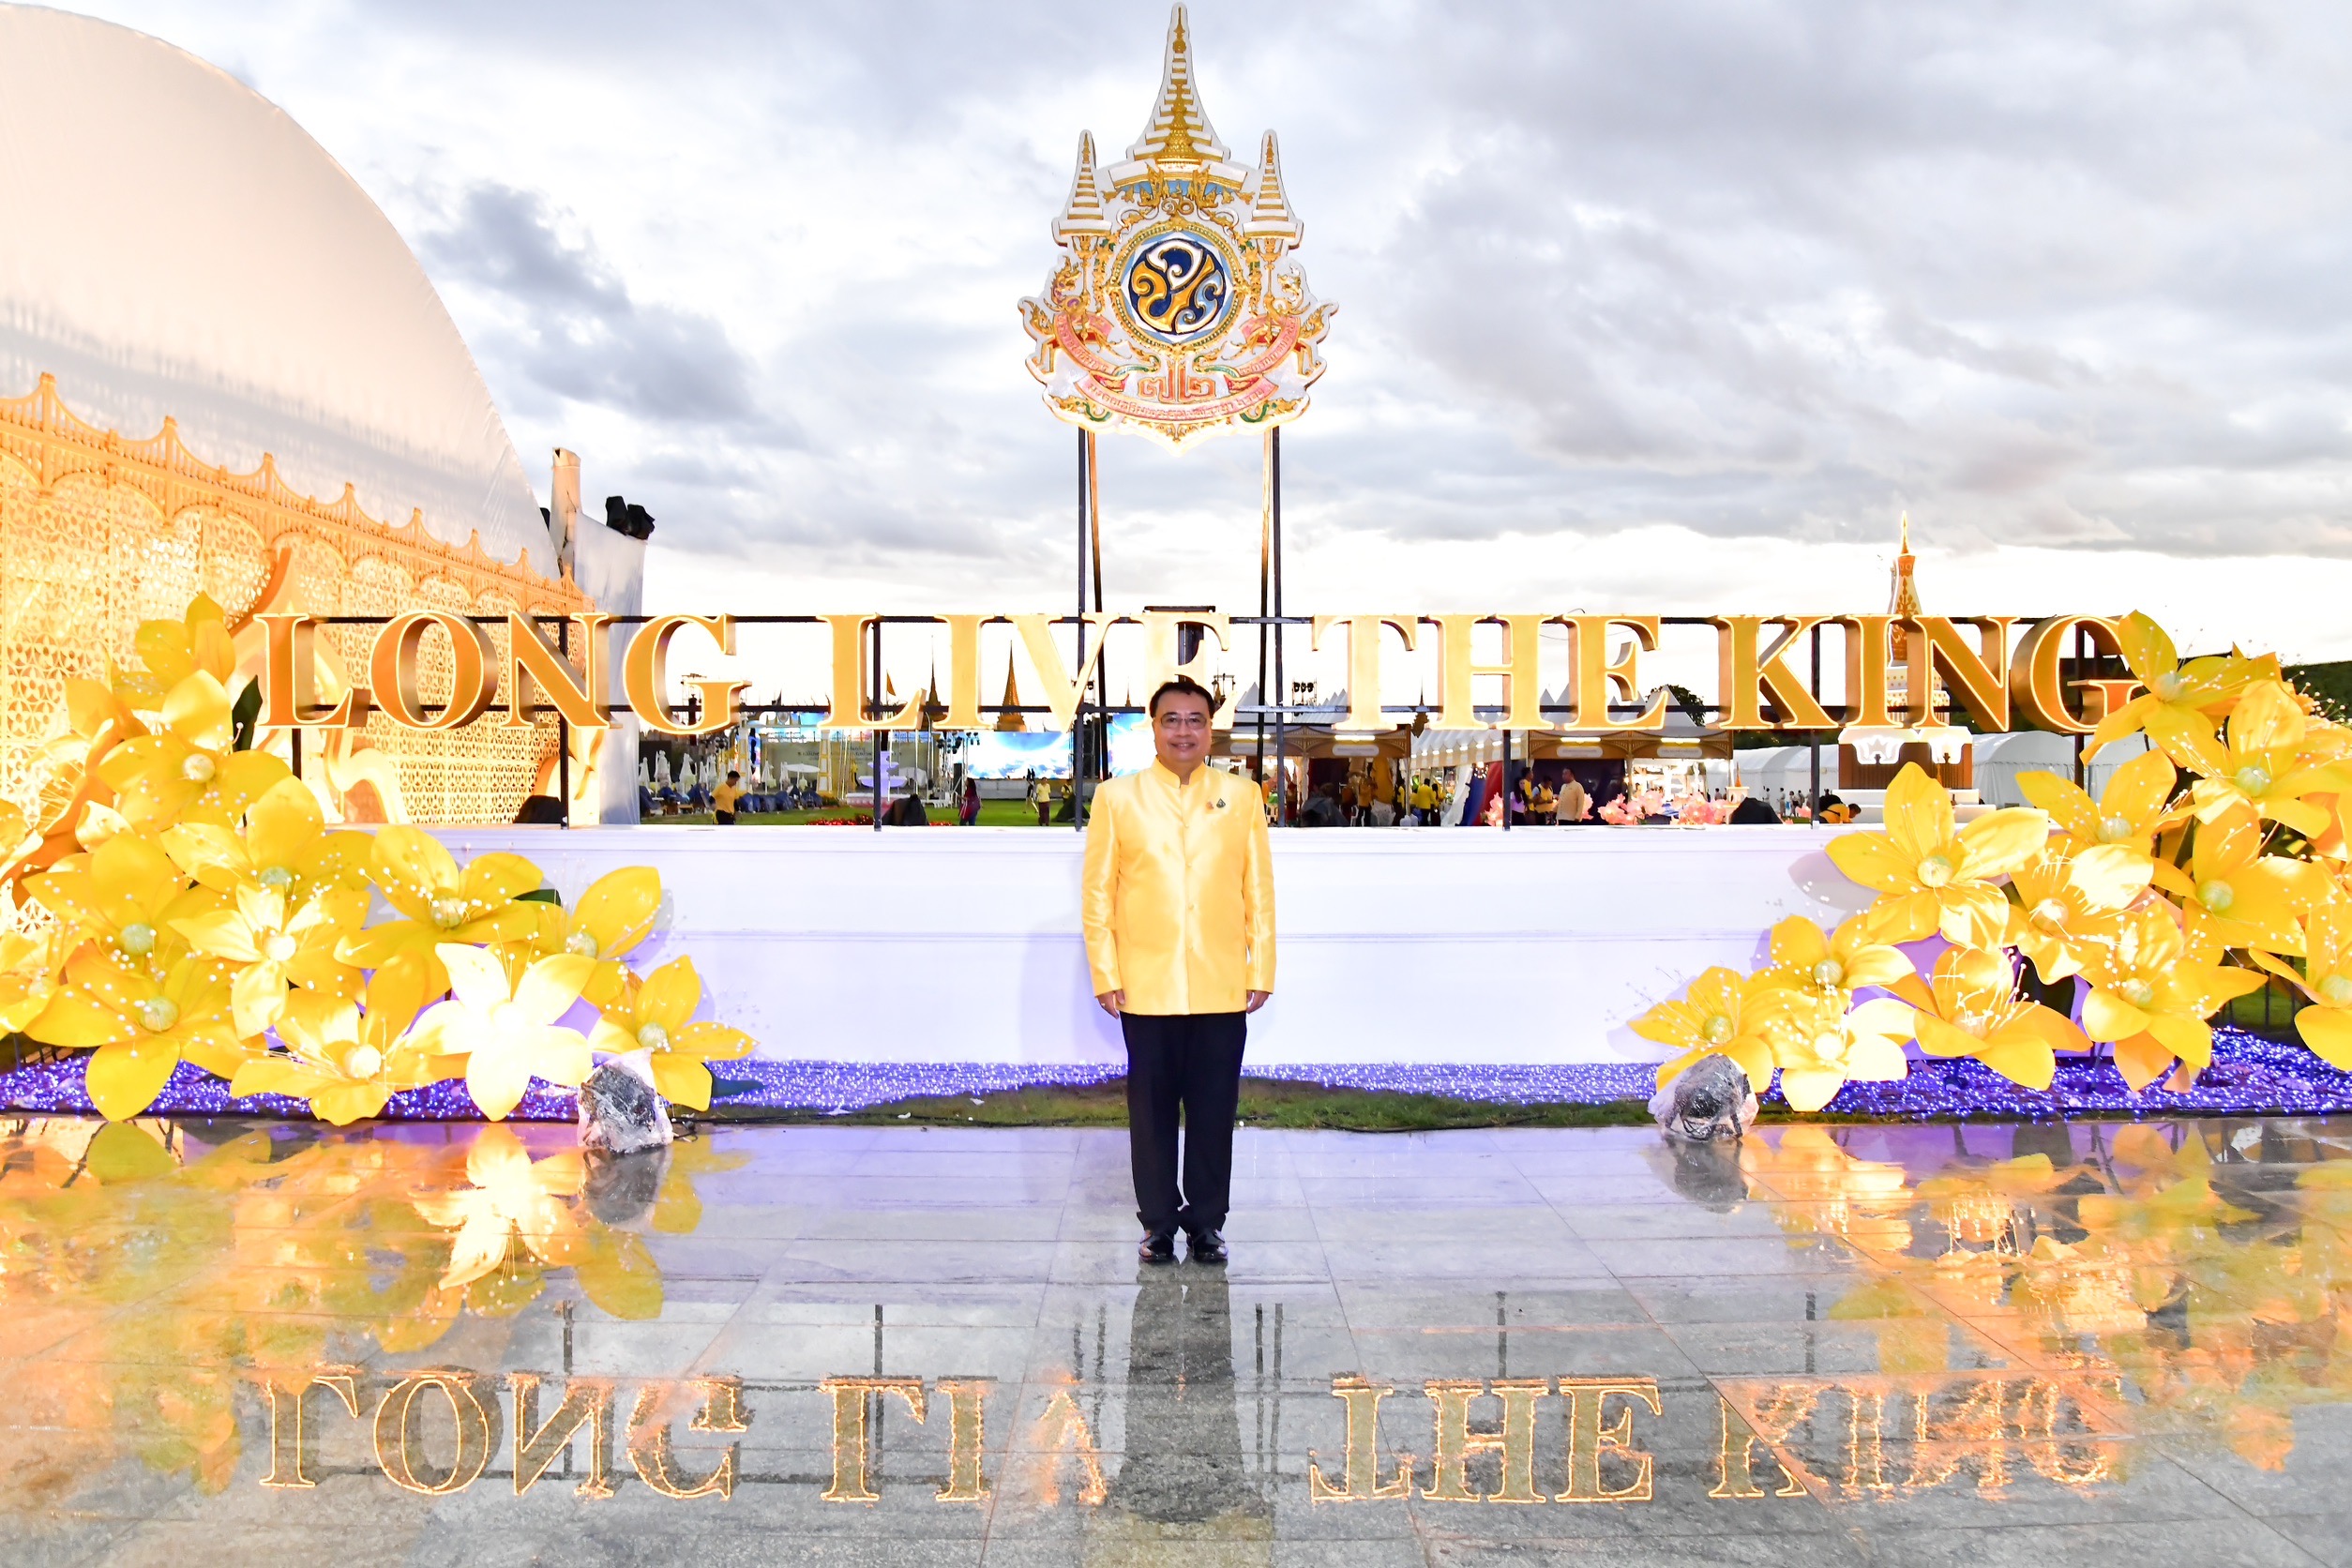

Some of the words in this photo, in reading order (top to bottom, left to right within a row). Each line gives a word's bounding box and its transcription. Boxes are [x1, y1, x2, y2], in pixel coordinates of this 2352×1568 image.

[253, 609, 749, 734] LONG
[816, 611, 1238, 732] LIVE
[1311, 612, 1668, 731] THE
[1714, 612, 2144, 733] KING
